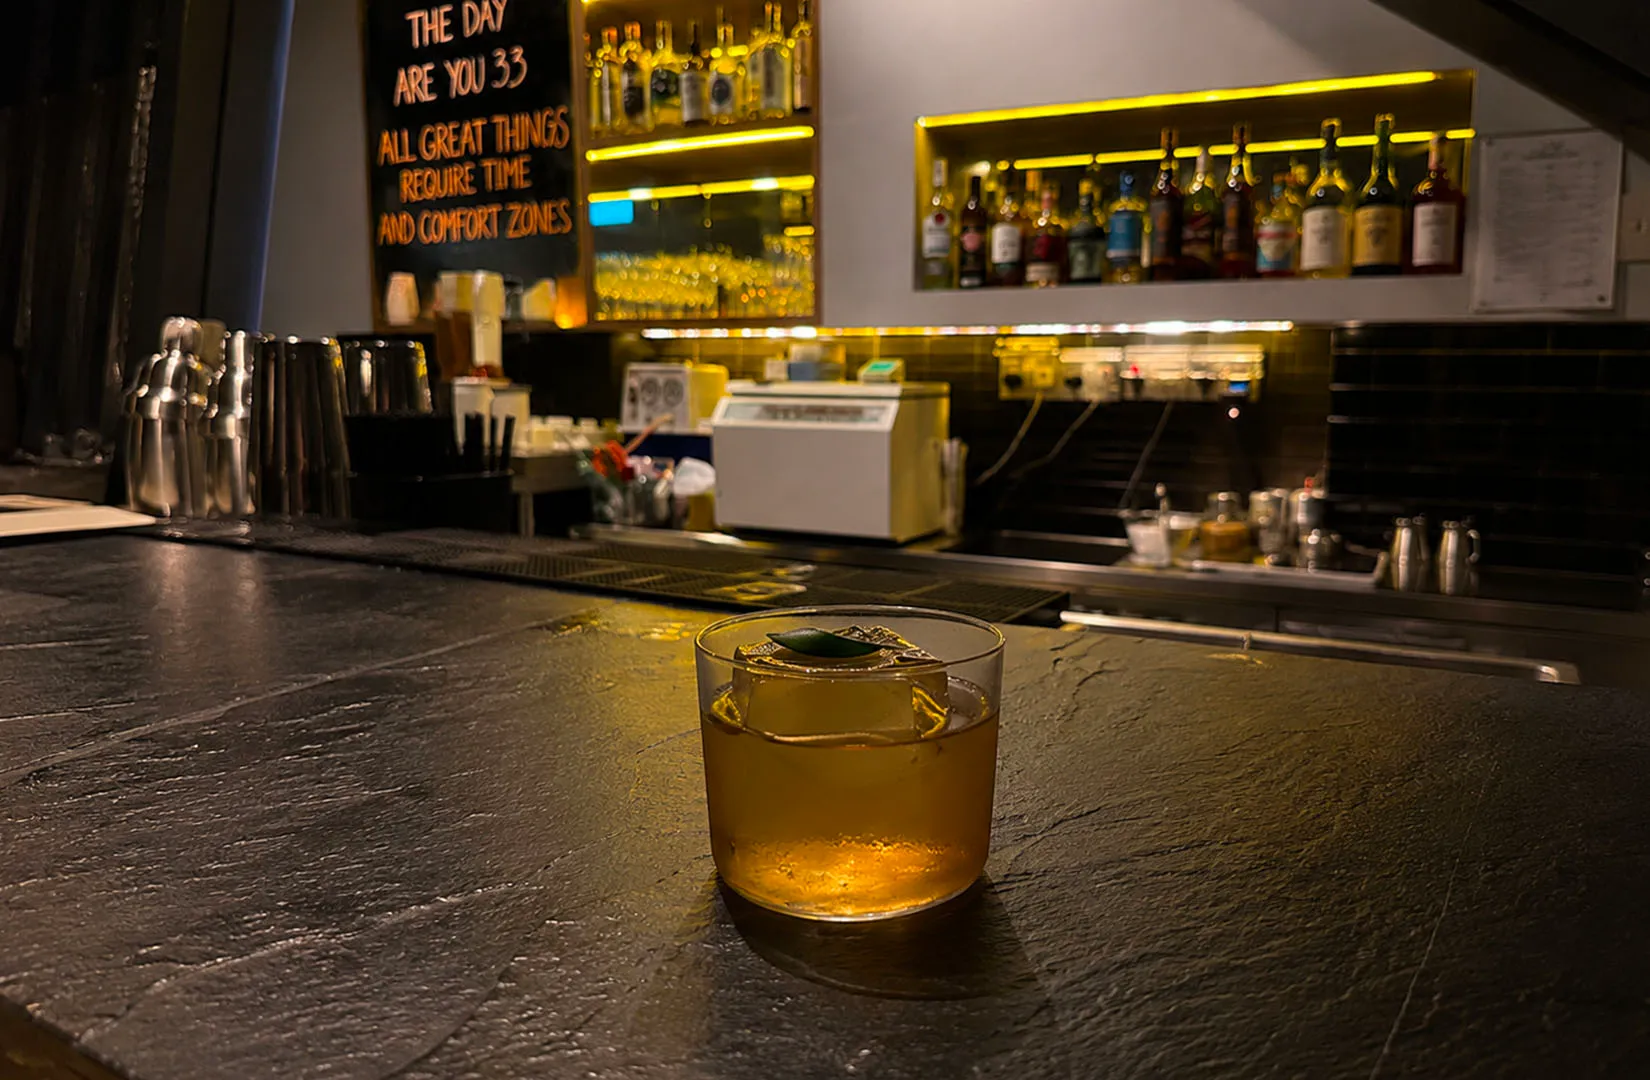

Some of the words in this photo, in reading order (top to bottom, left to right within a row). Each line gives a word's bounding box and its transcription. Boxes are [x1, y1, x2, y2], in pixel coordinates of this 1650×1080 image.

[405, 4, 454, 48] THE
[462, 0, 507, 38] DAY
[393, 63, 437, 107] ARE
[444, 54, 486, 99] YOU
[491, 45, 528, 89] 33
[377, 128, 417, 167] ALL
[418, 117, 488, 161] GREAT
[490, 105, 570, 153] THINGS
[399, 161, 477, 203] REQUIRE
[479, 153, 532, 192] TIME
[378, 210, 416, 246] AND
[418, 203, 503, 245] COMFORT
[505, 198, 572, 239] ZONES
